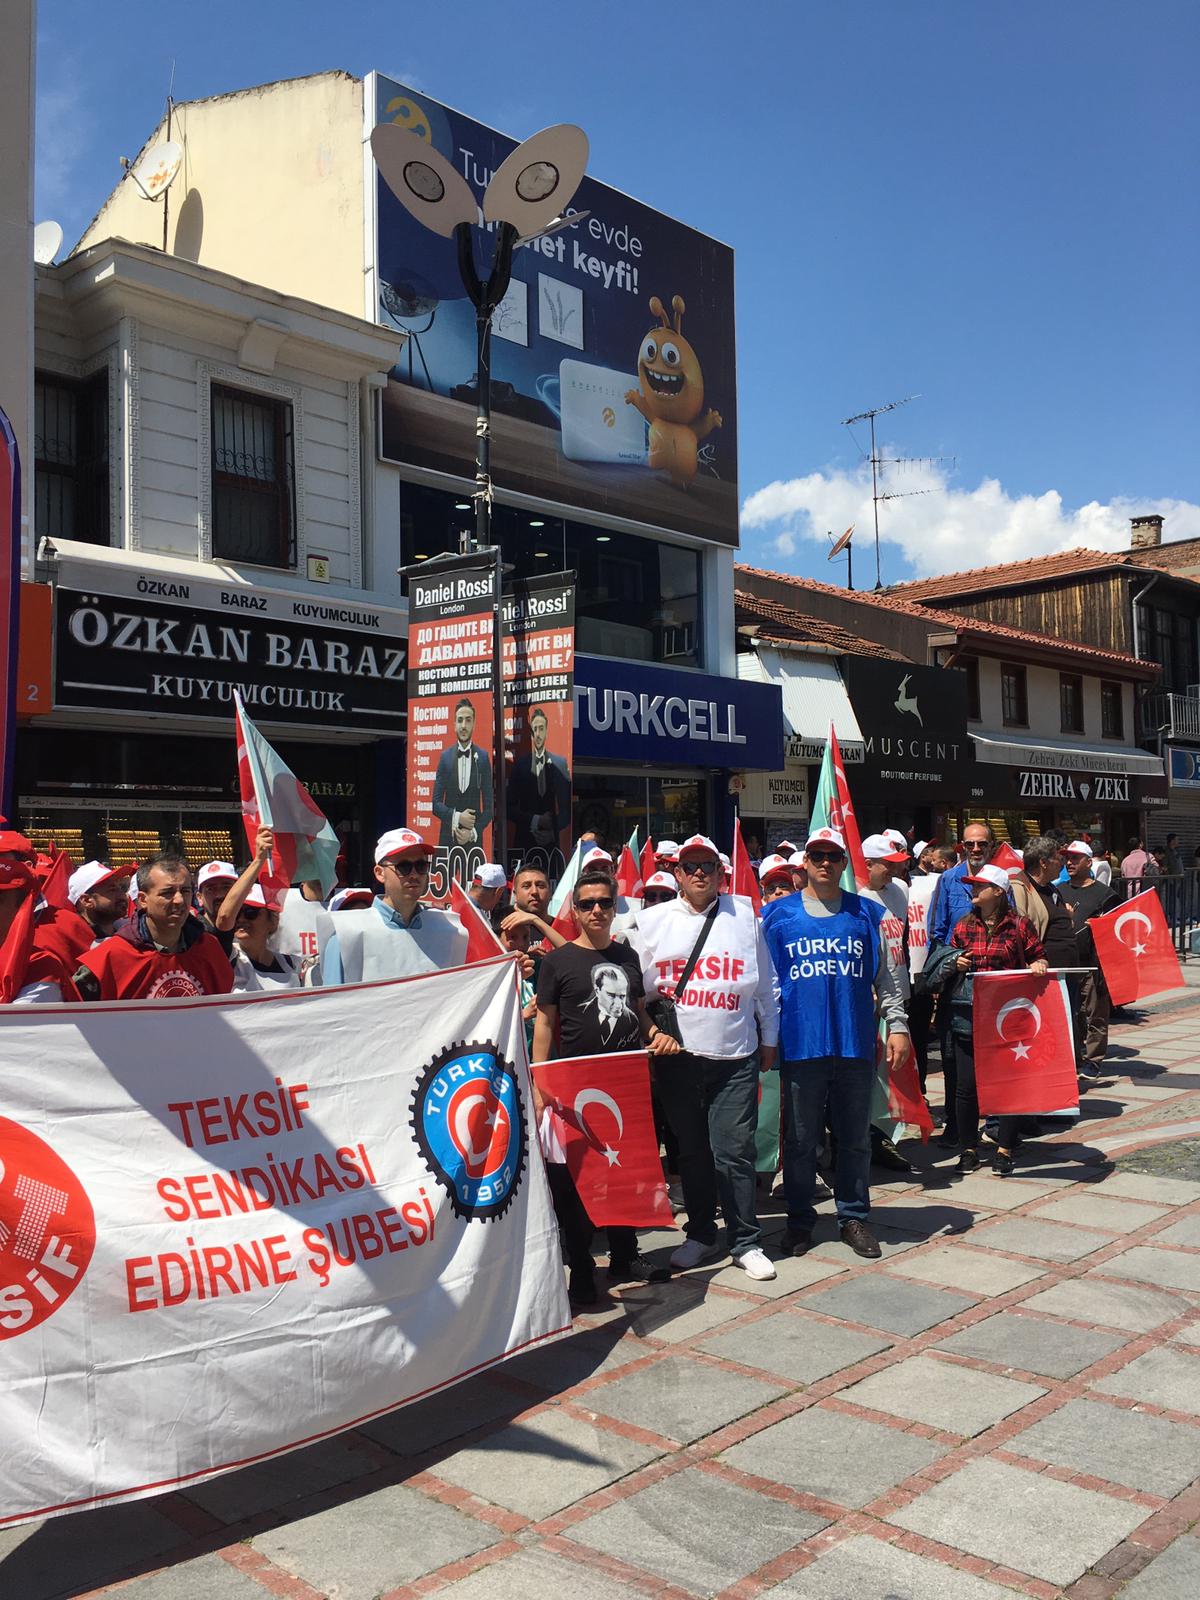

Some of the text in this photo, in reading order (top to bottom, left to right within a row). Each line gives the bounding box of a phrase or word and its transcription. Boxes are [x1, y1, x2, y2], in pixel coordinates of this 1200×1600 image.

[588, 219, 643, 258] evde
[573, 240, 639, 295] keyfi!
[136, 575, 380, 628] ÖZKAN BARAZ KUYUMCULUK
[415, 581, 454, 606] Daniel
[440, 603, 465, 615] London
[502, 599, 524, 621] niel
[69, 594, 405, 681] ÖZKAN BARAZ
[417, 629, 432, 645] ДО
[435, 621, 477, 641] ГАЩИТЕ
[553, 633, 571, 651] ВИ
[418, 667, 457, 681] КОСТЮМ
[467, 662, 492, 675] ЕЛЕК
[502, 650, 572, 676] АВАМЕ!
[27, 686, 39, 701] 2
[152, 674, 345, 712] KUYUMCULUK
[418, 677, 492, 696] ЦЯЛ КОМПЛЕКТ
[540, 675, 568, 688] ЕЛЕК
[573, 685, 747, 744] TURKCELL
[789, 743, 861, 761] KUYUMC RKAN
[880, 770, 943, 782] BOUTIQUE PERFUME
[1019, 772, 1130, 801] ZEHRA ZEKİ
[772, 793, 803, 807] ERKAN
[429, 845, 488, 900] 500
[907, 901, 925, 924] SİF
[785, 935, 864, 958] TÜRK-İŞ
[656, 951, 744, 982] TEKSİF
[789, 959, 864, 981] GÖREVLİ
[657, 985, 741, 1011] SENDİKASI
[168, 1077, 310, 1148] TEKSİF
[157, 1143, 377, 1222] SENDİKASI
[462, 1166, 512, 1202] 1952
[125, 1187, 436, 1313] EDİRNE ŞUBESİ
[0, 1235, 80, 1330] SİF
